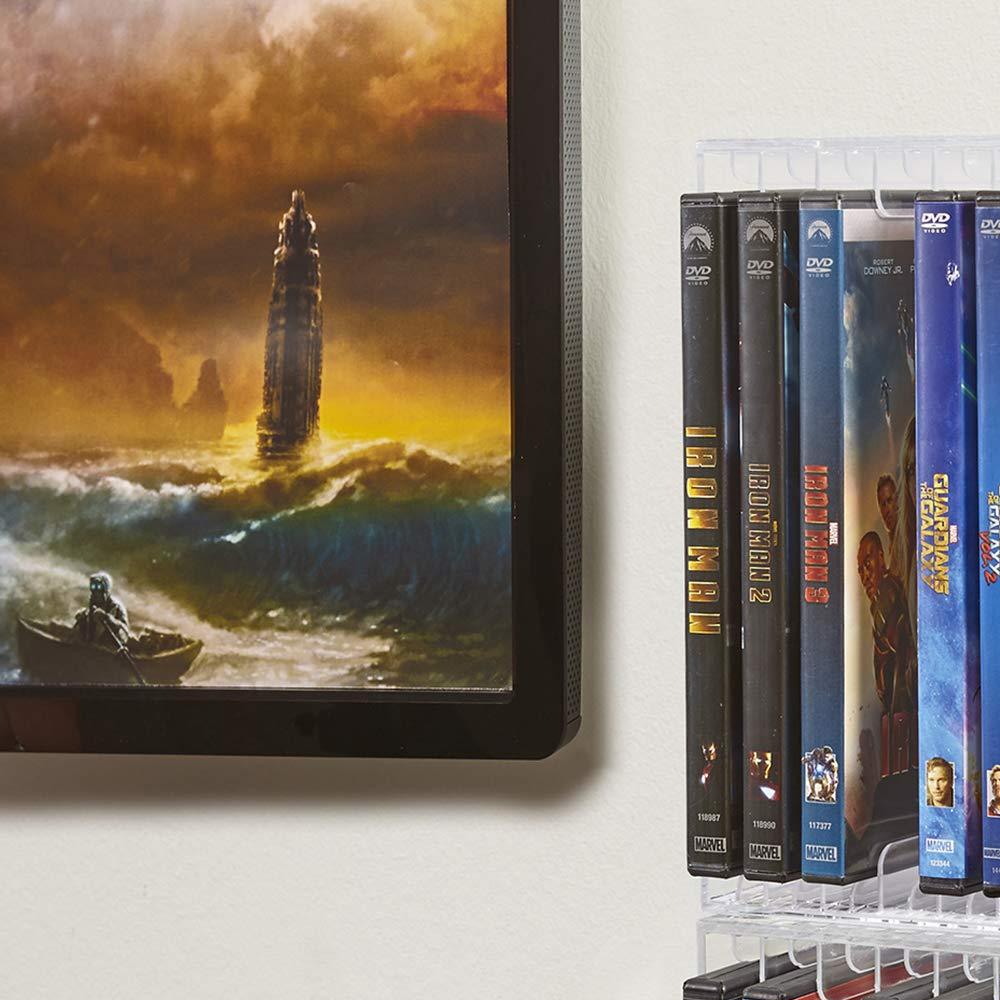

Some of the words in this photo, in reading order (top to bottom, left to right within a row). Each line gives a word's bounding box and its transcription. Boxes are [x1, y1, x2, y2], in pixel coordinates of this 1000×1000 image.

[921, 213, 950, 222] DVD
[685, 266, 712, 275] DVD
[747, 260, 774, 270] DVD
[806, 258, 833, 267] DVD
[864, 266, 891, 275] DOWNEY
[685, 427, 719, 529] IRON
[749, 464, 770, 523] IRON
[804, 465, 828, 524] IRON
[829, 522, 838, 545] MARVEL
[933, 473, 949, 595] GUARDIANS
[920, 500, 935, 591] GALAXY
[988, 505, 1000, 580] GALAXY
[749, 530, 771, 582] MAN
[804, 530, 829, 582] MAN
[688, 546, 721, 634] MAN
[749, 588, 772, 603] 2
[805, 587, 830, 604] 3
[698, 813, 720, 822] 118987
[808, 822, 832, 830] 117377
[694, 836, 726, 853] MARVEL
[750, 843, 781, 860] MARVEL
[805, 844, 837, 862] MARVEL
[926, 838, 954, 853] MARVEL
